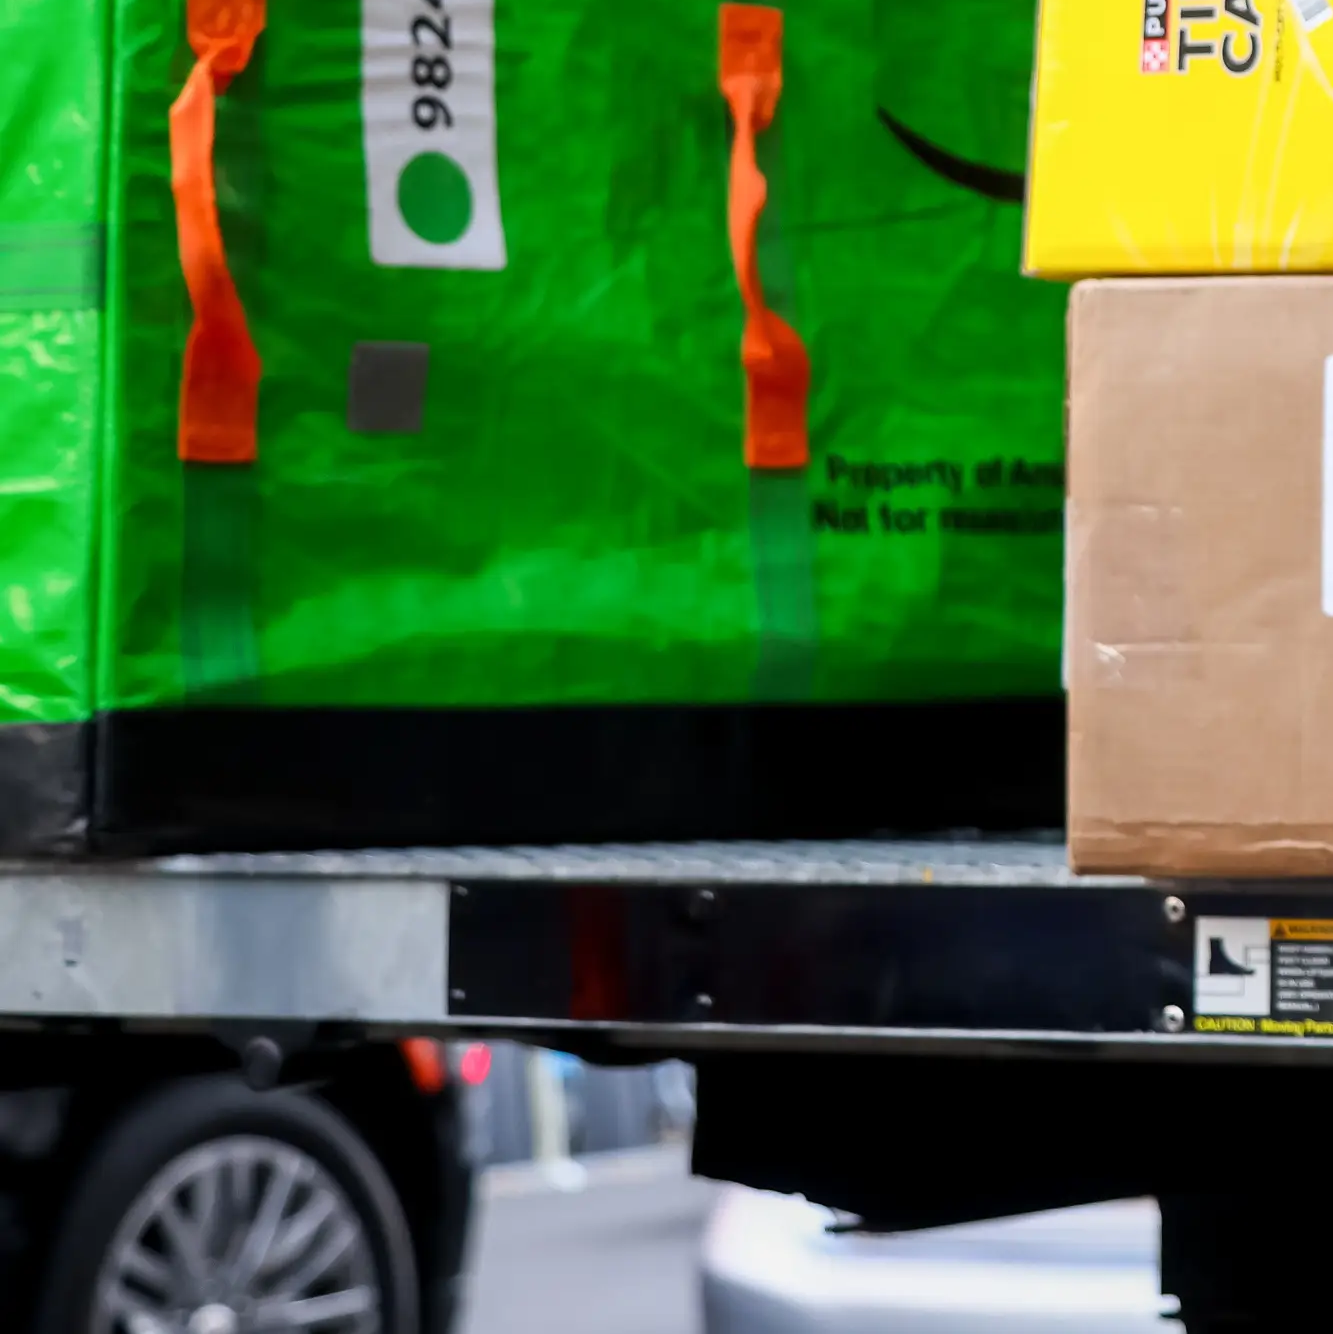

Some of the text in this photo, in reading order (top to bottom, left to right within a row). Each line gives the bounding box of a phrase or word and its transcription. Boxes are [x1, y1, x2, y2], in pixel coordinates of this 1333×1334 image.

[825, 454, 964, 494] Property
[813, 500, 868, 532] Not
[878, 500, 927, 532] for
